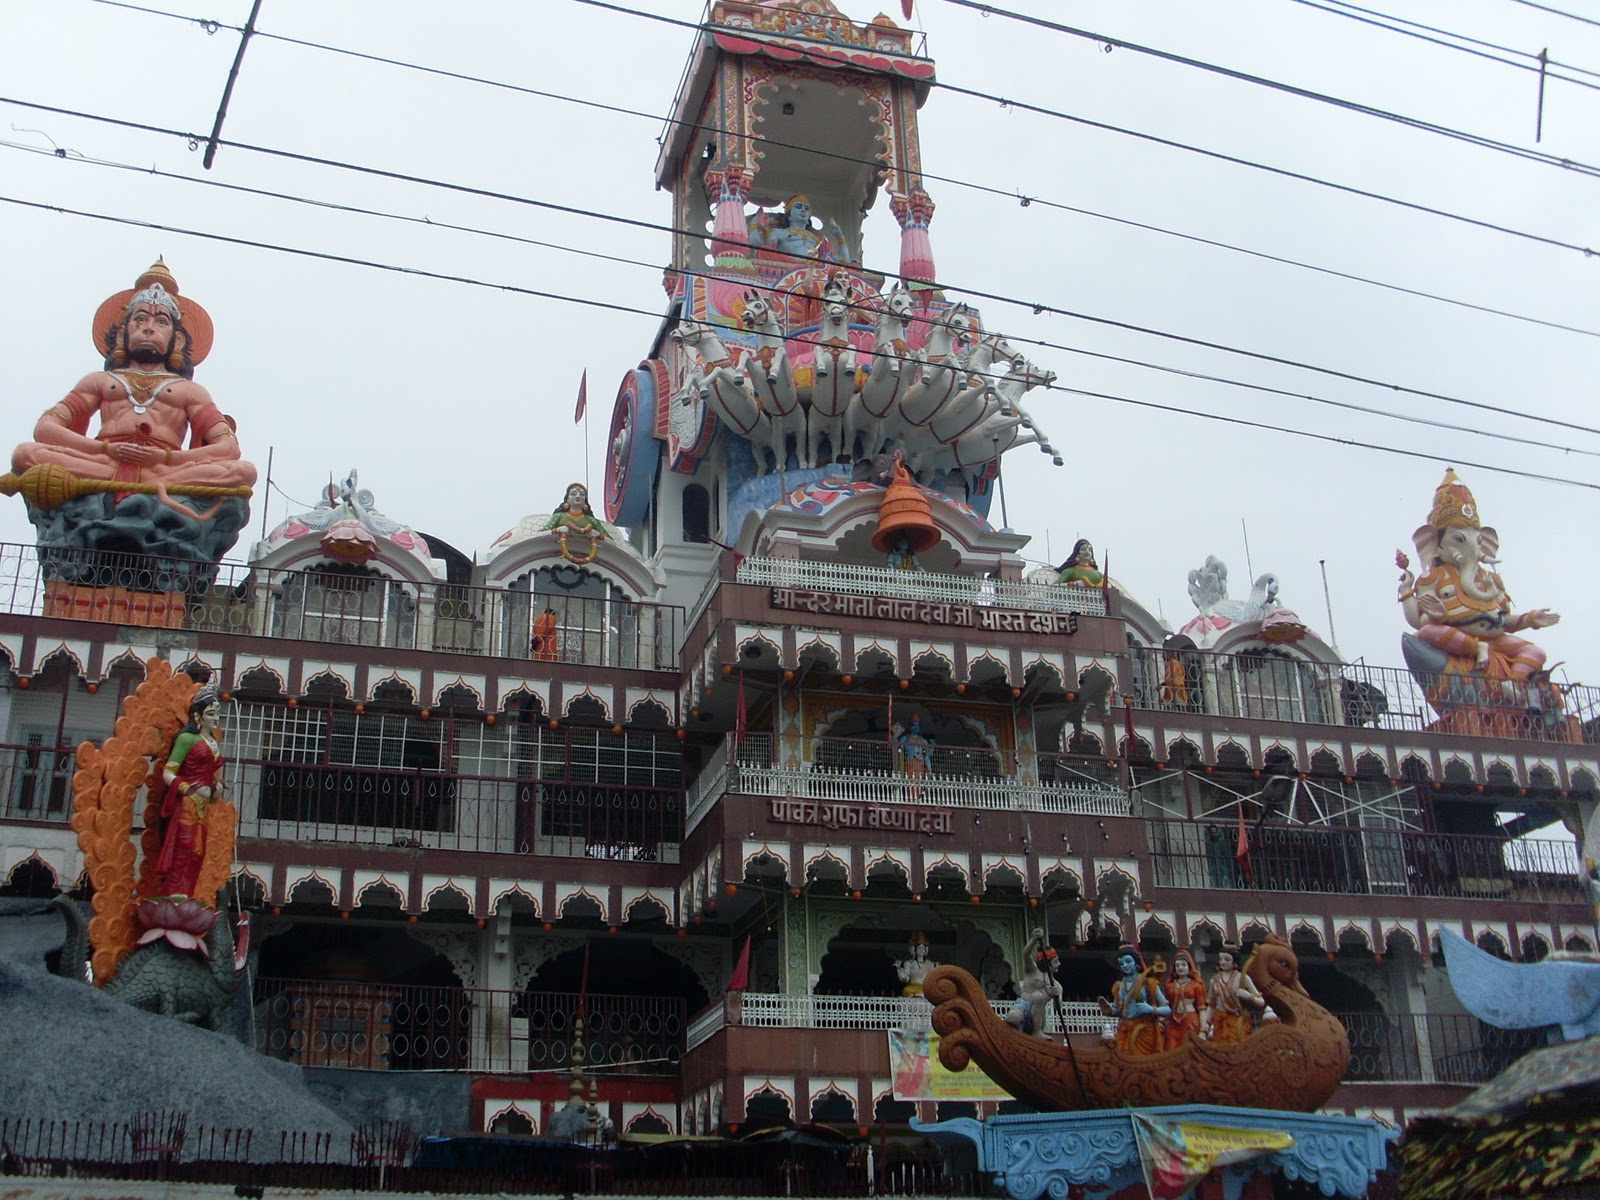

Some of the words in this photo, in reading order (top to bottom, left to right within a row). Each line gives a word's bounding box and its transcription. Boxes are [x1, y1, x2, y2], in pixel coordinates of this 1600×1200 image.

[835, 595, 875, 616] माता
[877, 597, 918, 620] लाल
[919, 600, 951, 625] देवी
[951, 603, 973, 626] जी
[979, 610, 1025, 631] भारत
[1027, 608, 1071, 634] दर्शन
[772, 797, 819, 824] पवित्र
[822, 803, 864, 830] गुफा
[919, 806, 953, 833] देवी
